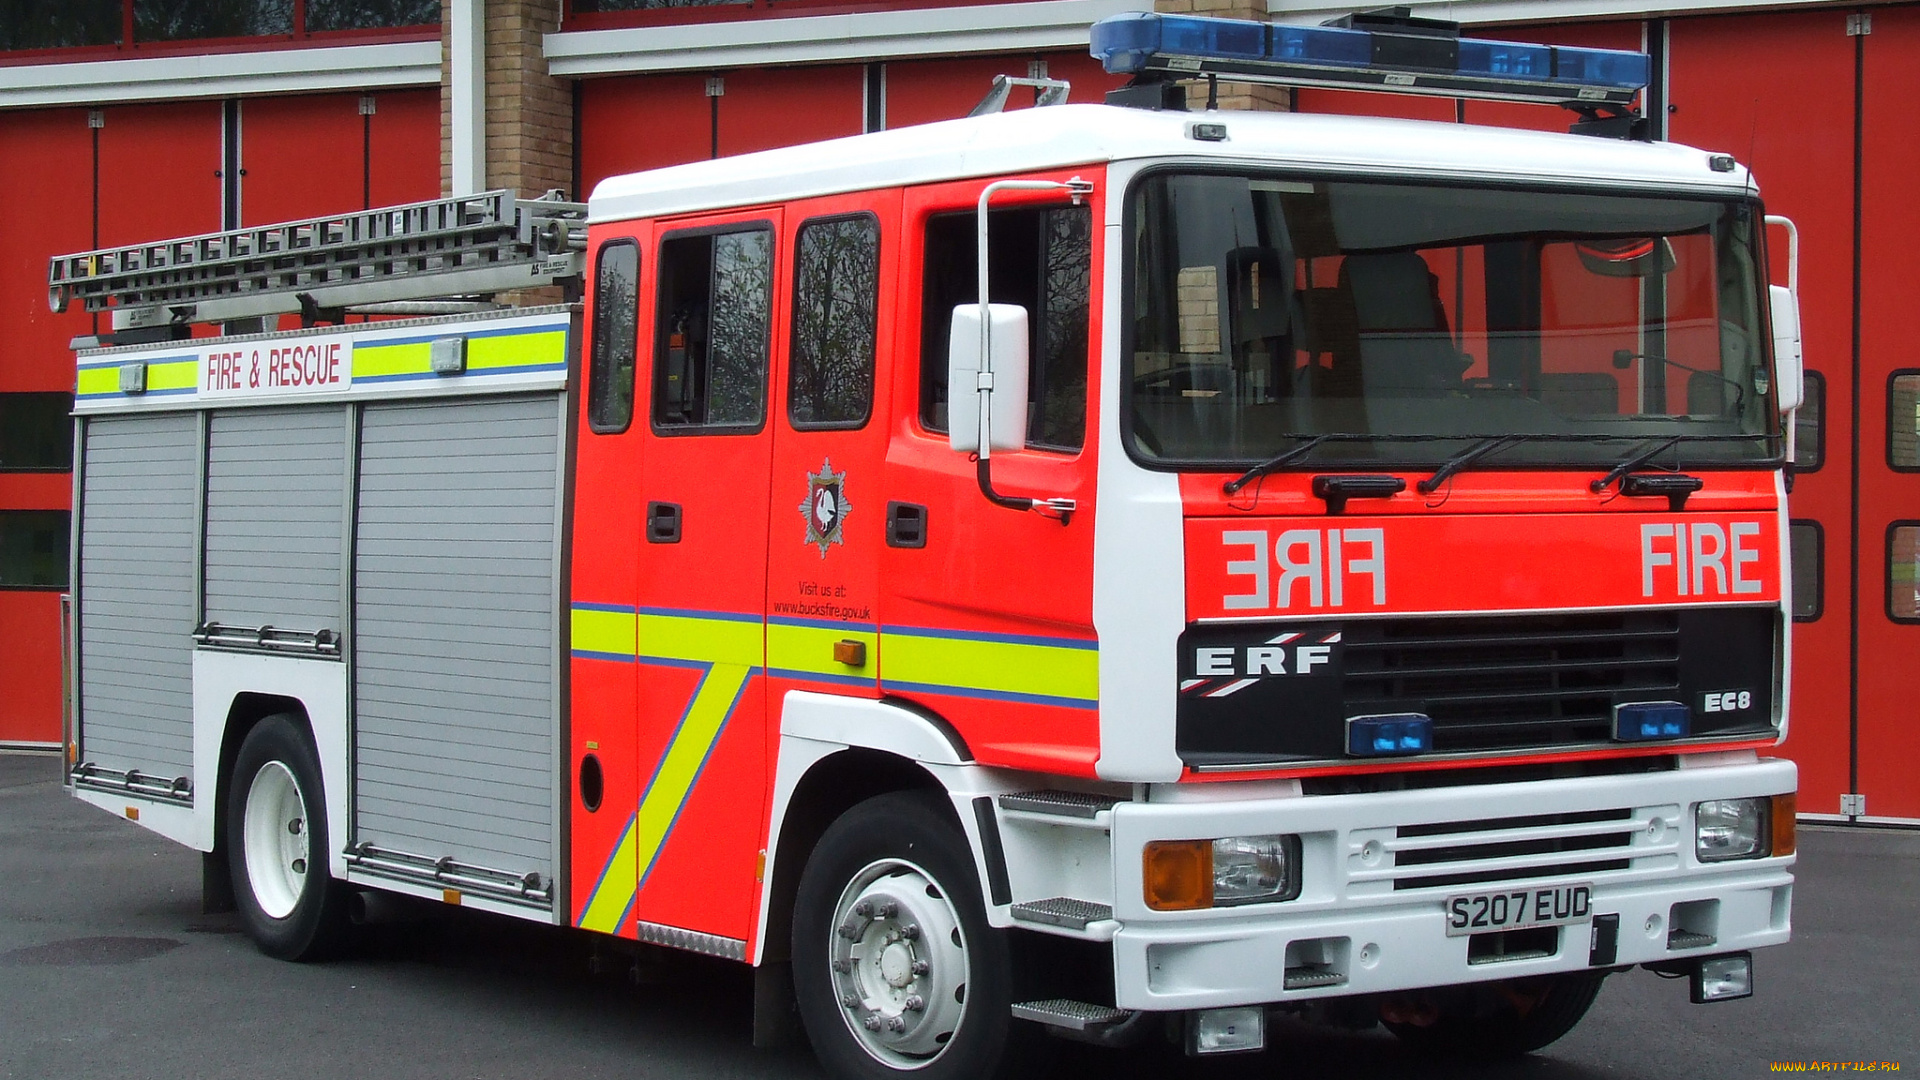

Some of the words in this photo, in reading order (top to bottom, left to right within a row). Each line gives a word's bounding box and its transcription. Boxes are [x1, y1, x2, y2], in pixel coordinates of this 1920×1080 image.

[207, 351, 242, 391] FIRE
[249, 350, 261, 389] &
[268, 343, 341, 387] RESCUE
[1640, 522, 1762, 597] FIRE
[798, 581, 818, 596] Visit
[820, 586, 832, 597] us
[834, 585, 847, 598] at:
[773, 601, 871, 621] www.bucksfire.gov.uk
[1196, 646, 1331, 676] ERF
[1704, 691, 1751, 712] EC8
[1451, 891, 1528, 929] S207
[1535, 886, 1590, 922] EUD
